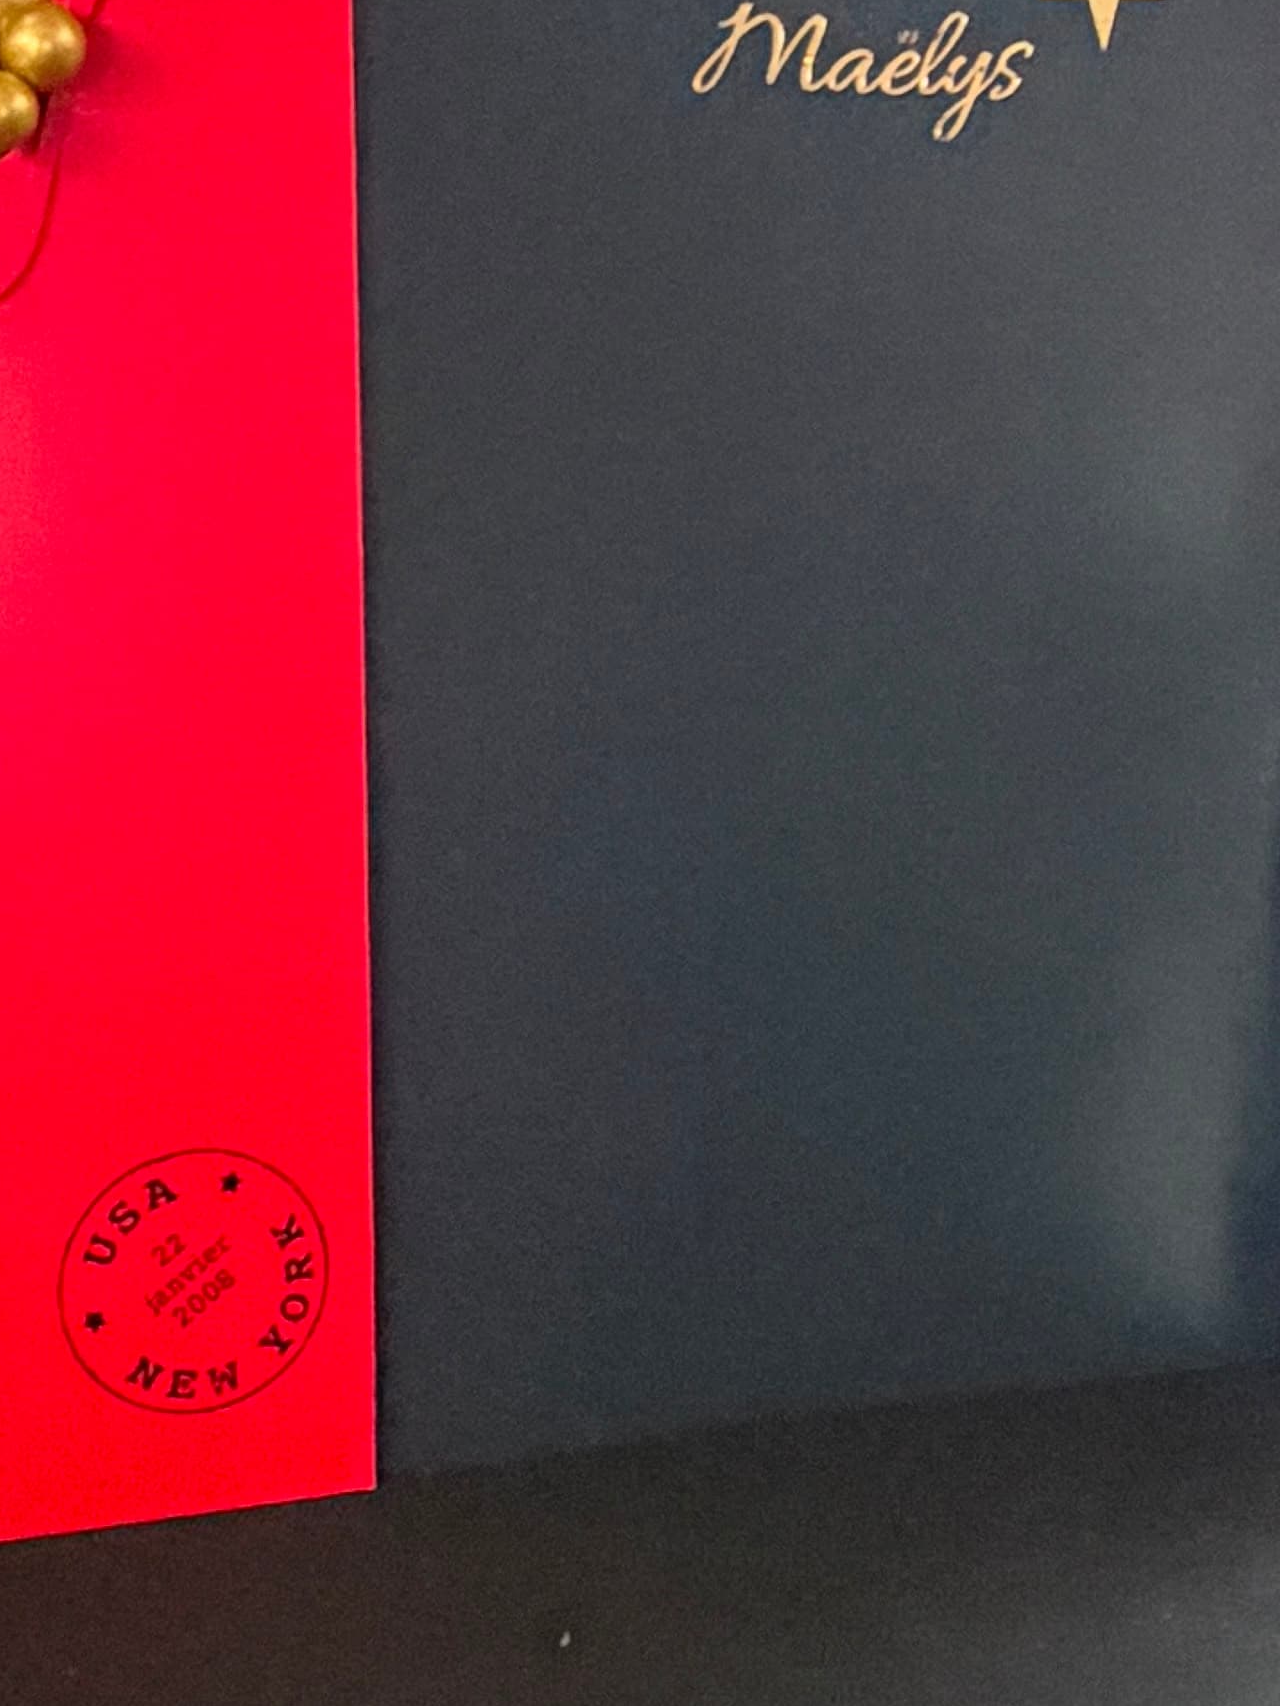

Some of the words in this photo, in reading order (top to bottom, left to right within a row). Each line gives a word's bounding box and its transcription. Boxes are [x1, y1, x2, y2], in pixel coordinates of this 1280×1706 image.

[691, 1, 1035, 142] Maëlys
[83, 1178, 178, 1266] USA
[150, 1232, 187, 1268] 22
[125, 1355, 239, 1399] NEW
[258, 1212, 315, 1357] YORK
[171, 1268, 237, 1329] 2008
